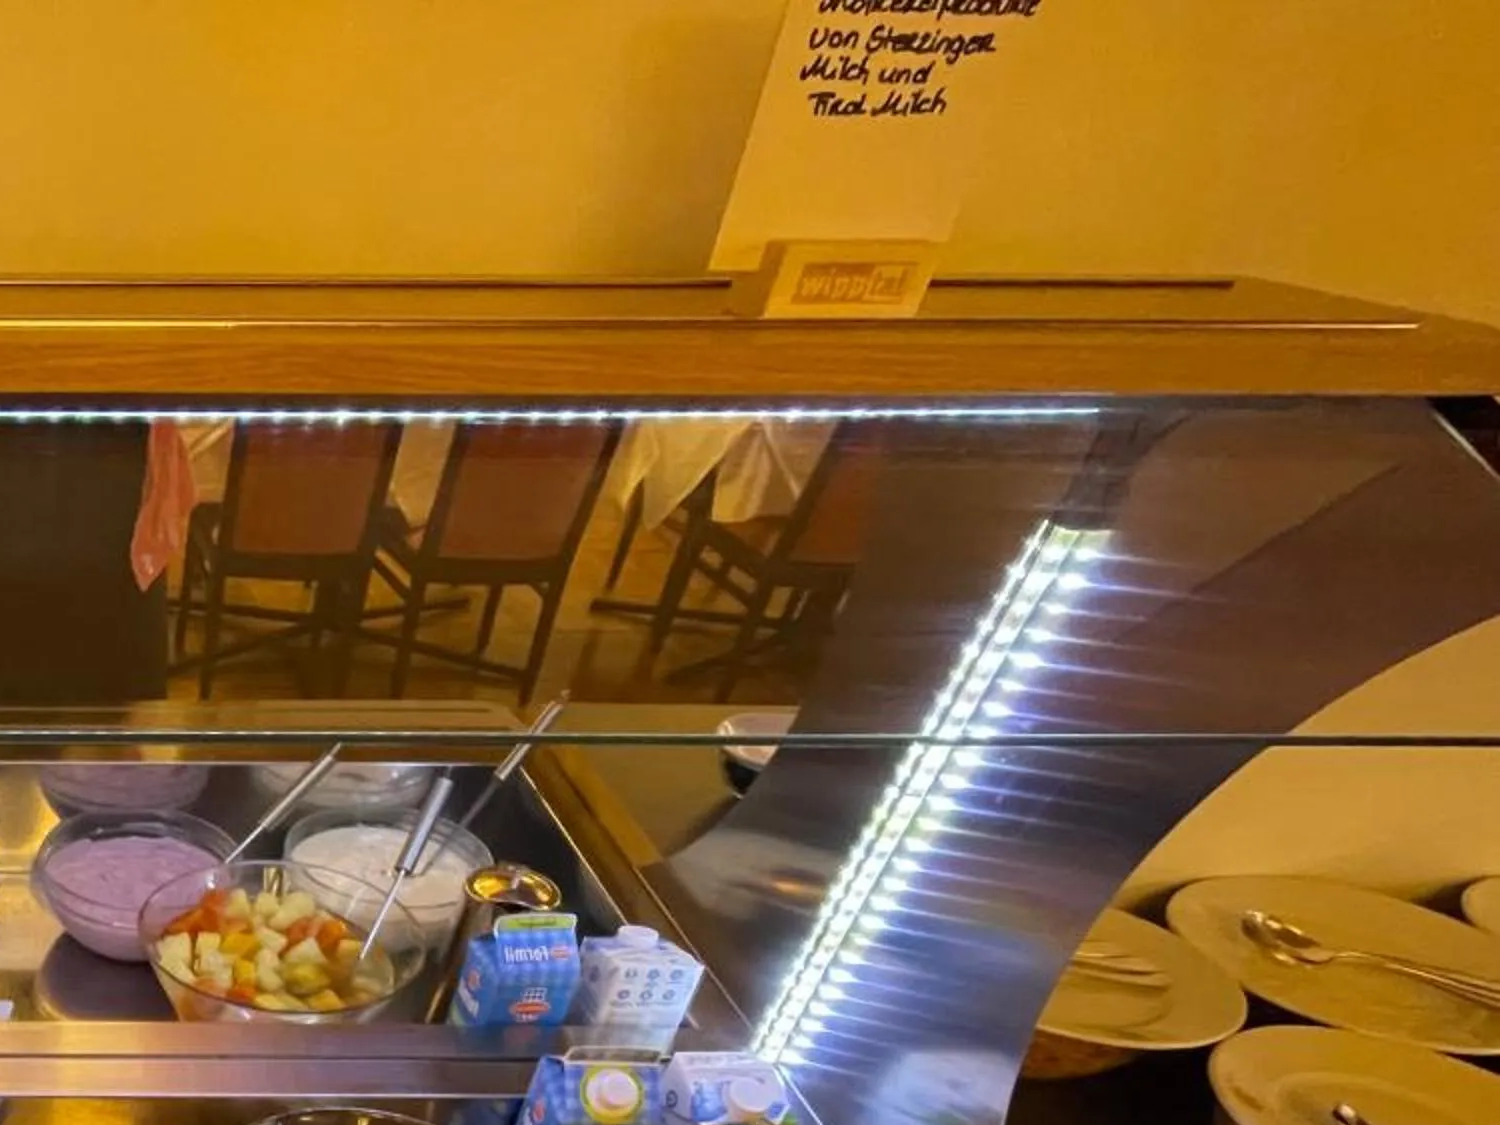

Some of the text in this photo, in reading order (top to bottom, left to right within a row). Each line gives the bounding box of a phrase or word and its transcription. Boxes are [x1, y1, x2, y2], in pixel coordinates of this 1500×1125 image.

[800, 56, 936, 85] Milch und
[871, 87, 947, 117] Milch
